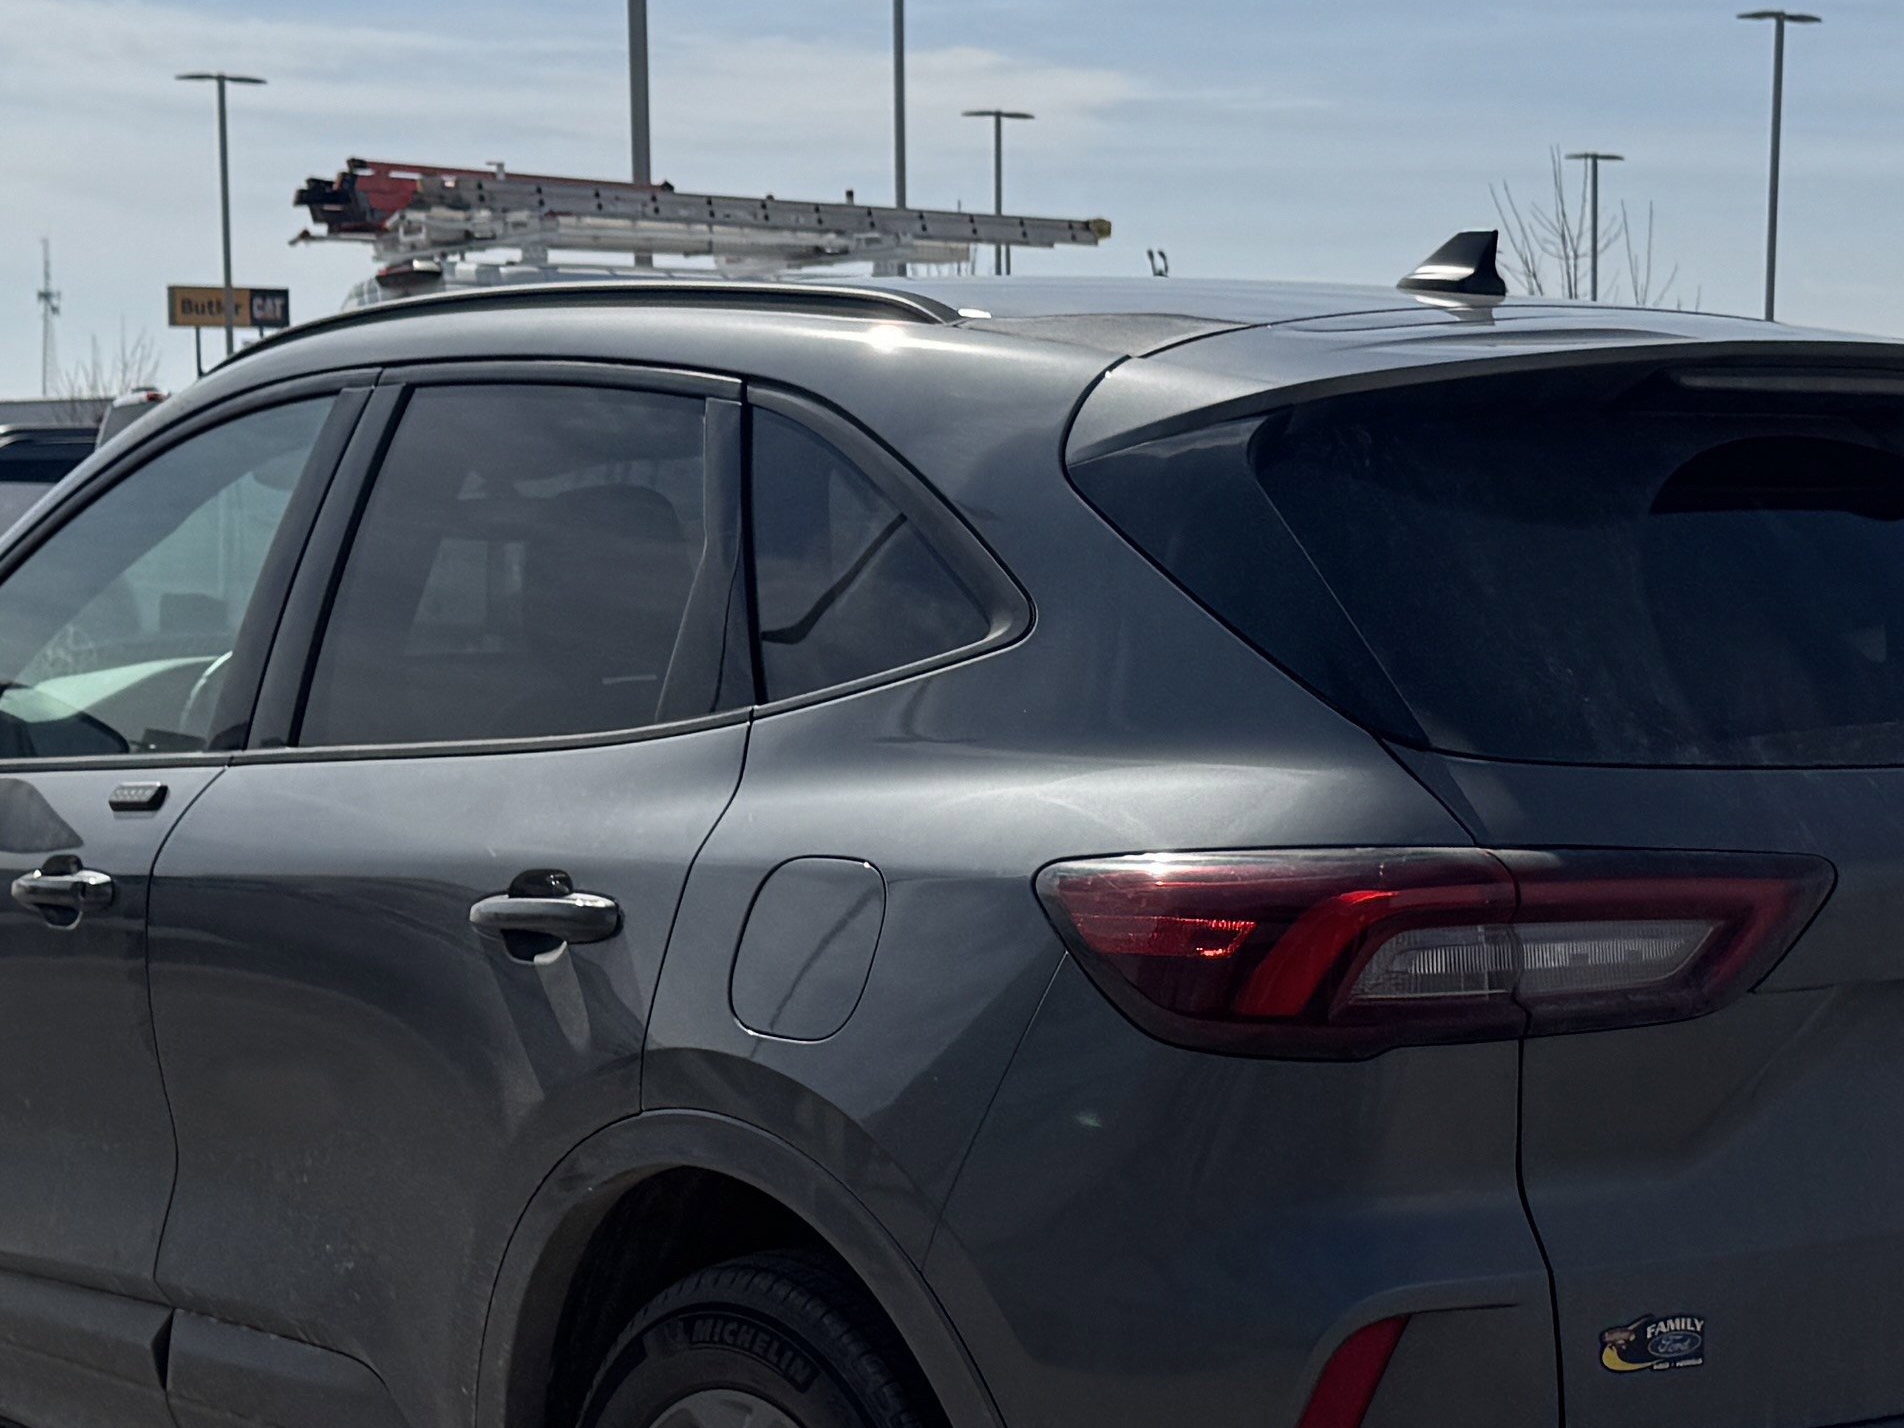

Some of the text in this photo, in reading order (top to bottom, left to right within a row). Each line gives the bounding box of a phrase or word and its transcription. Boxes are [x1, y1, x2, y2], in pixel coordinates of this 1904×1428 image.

[181, 296, 284, 320] Butlr CAT
[1646, 1317, 1704, 1339] FAMILY
[690, 1317, 813, 1383] MICHELIN
